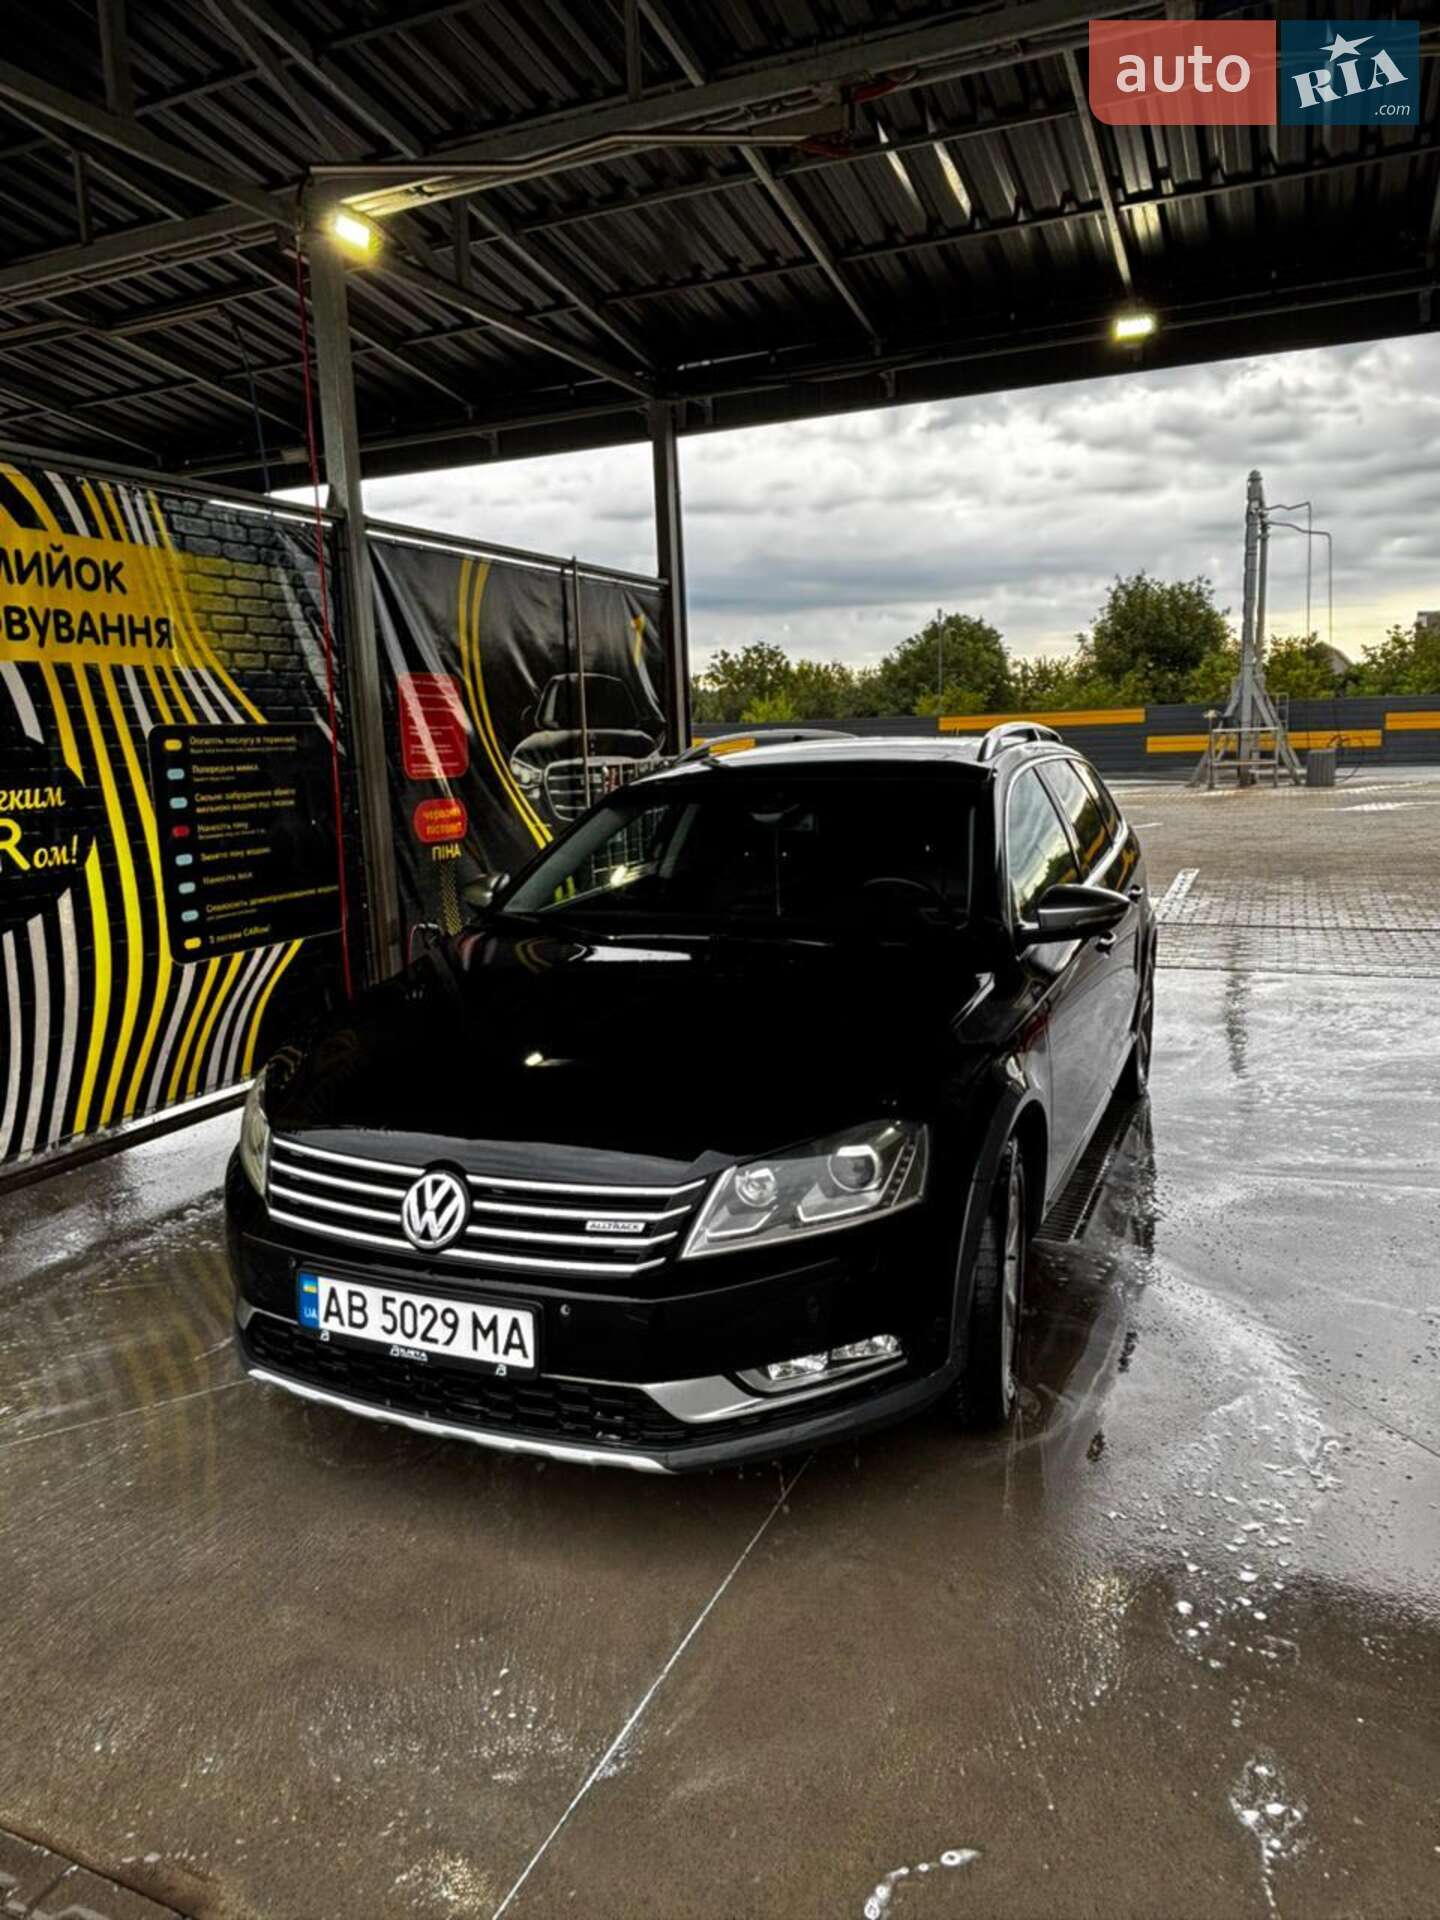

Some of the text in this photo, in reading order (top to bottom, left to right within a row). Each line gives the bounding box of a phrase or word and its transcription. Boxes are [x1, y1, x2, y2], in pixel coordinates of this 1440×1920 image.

[0, 605, 174, 649] ВУВАННЯ
[432, 843, 461, 860] ПІНА
[304, 1307, 317, 1319] UA
[323, 1286, 530, 1360] AB 5029 MA
